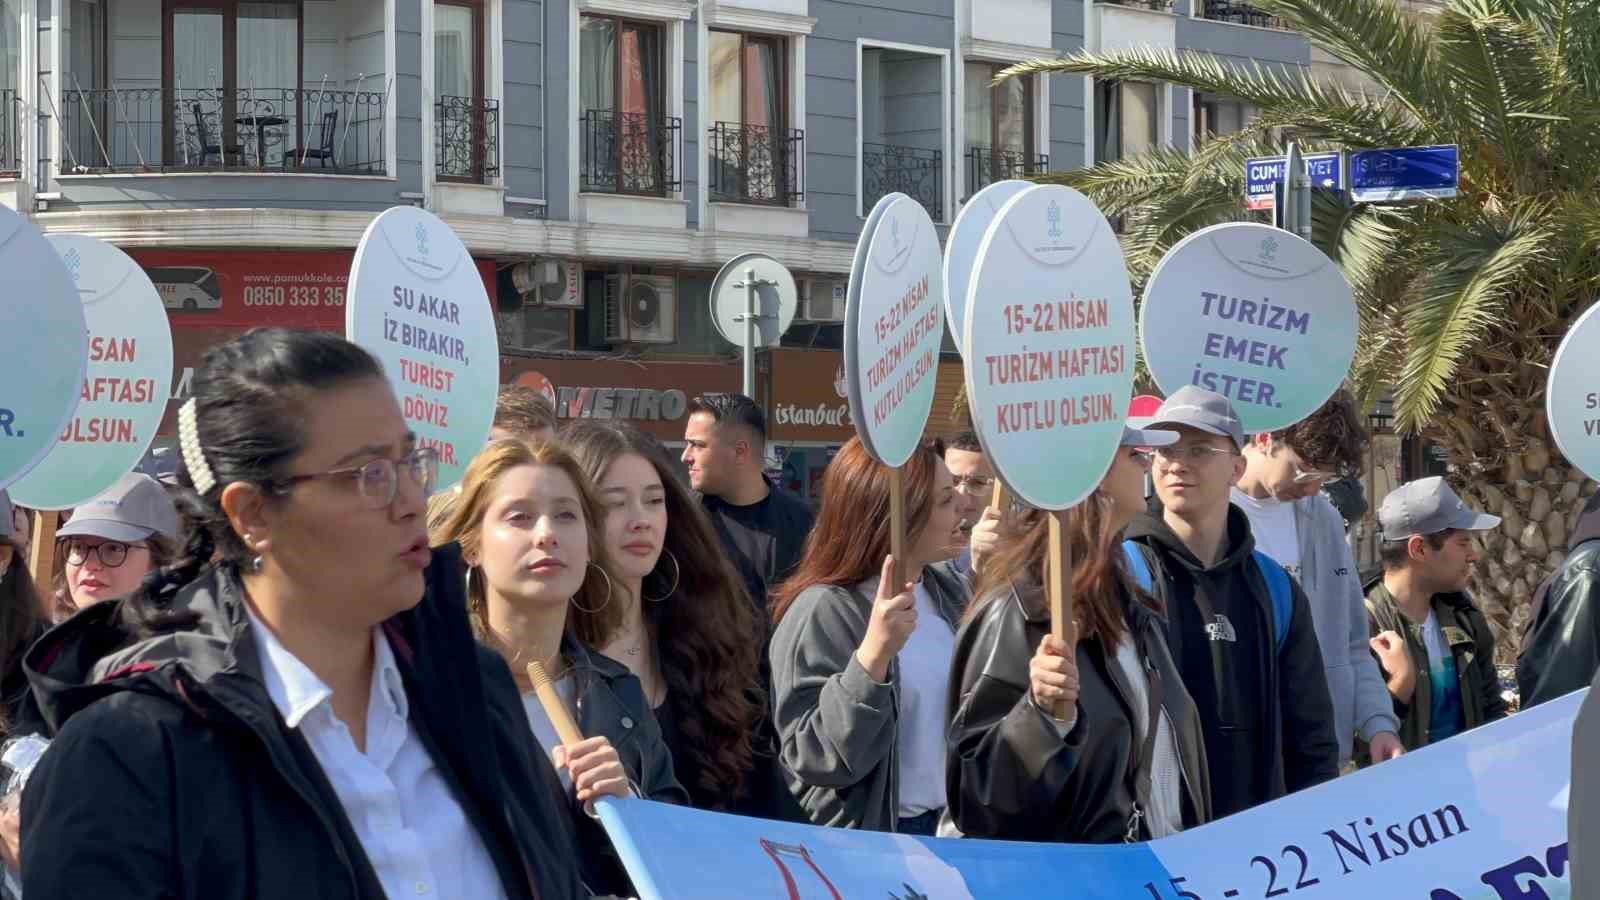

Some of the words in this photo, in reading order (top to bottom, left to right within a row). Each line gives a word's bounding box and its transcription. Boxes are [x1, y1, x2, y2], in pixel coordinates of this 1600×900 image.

[1250, 159, 1333, 181] CUMHİYET
[244, 286, 284, 306] 0850
[289, 287, 319, 306] 333
[324, 287, 345, 306] 35
[393, 286, 414, 310] SU
[418, 293, 460, 325] AKAR
[873, 303, 902, 344] 15-22
[902, 274, 929, 316] NİSAN
[1004, 303, 1056, 335] 15-22
[1058, 292, 1108, 331] NİSAN
[1201, 291, 1310, 335] TURİZM
[384, 312, 398, 342] İZ
[402, 323, 469, 366] BIRAKIR,
[867, 340, 902, 392] TURİZM
[903, 303, 938, 353] HAFTASI
[1203, 333, 1288, 370] EMEK
[400, 359, 454, 393] TURİST
[985, 345, 1053, 386] TURİZM
[1058, 344, 1124, 378] HAFTASI
[1191, 363, 1282, 408] İSTER.
[556, 386, 687, 420] METRO
[873, 379, 904, 428] KUTLU
[905, 348, 935, 394] OLSUN.
[404, 394, 448, 428] DÖVİZ
[997, 400, 1056, 434] KUTLU
[1060, 393, 1118, 426] OLSUN.
[1251, 844, 1320, 898] 22
[1321, 803, 1471, 875] Nisan
